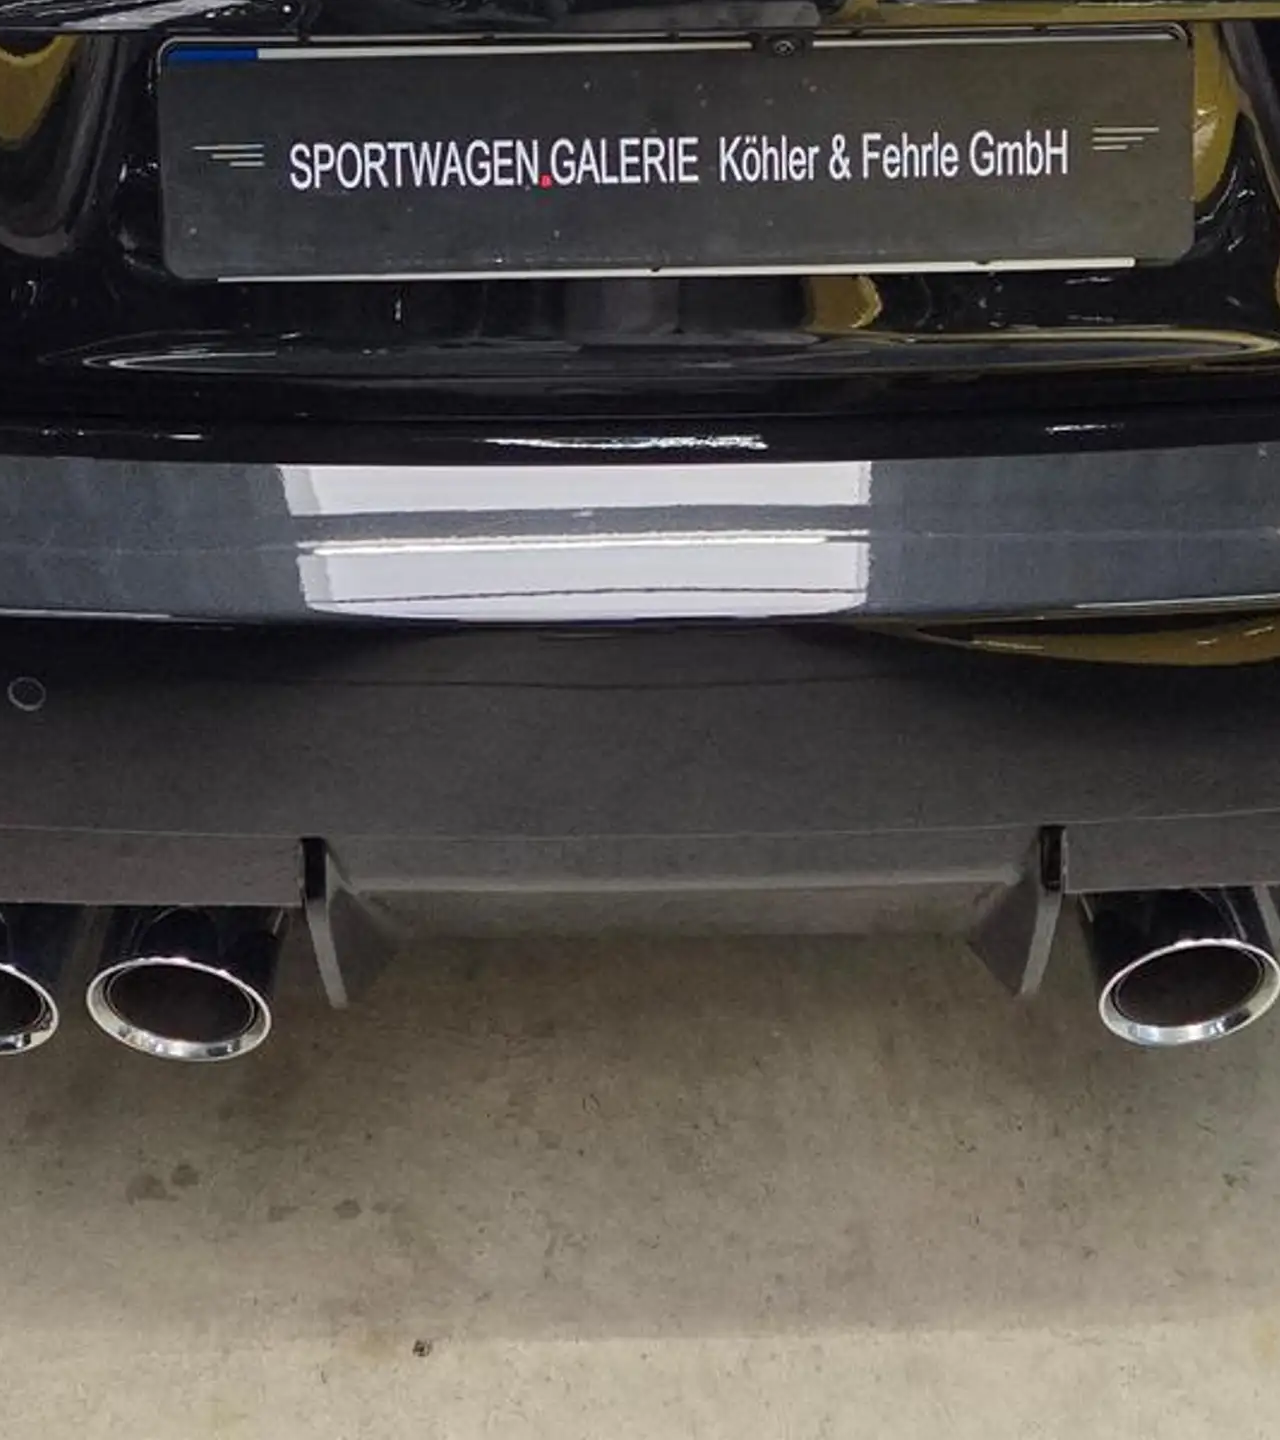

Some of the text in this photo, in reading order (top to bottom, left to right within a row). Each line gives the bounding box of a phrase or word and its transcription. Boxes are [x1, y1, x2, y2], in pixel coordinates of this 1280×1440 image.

[289, 128, 1069, 190] SPORTWAGEN.GALERIE Köhler & Fehrle GmbH
